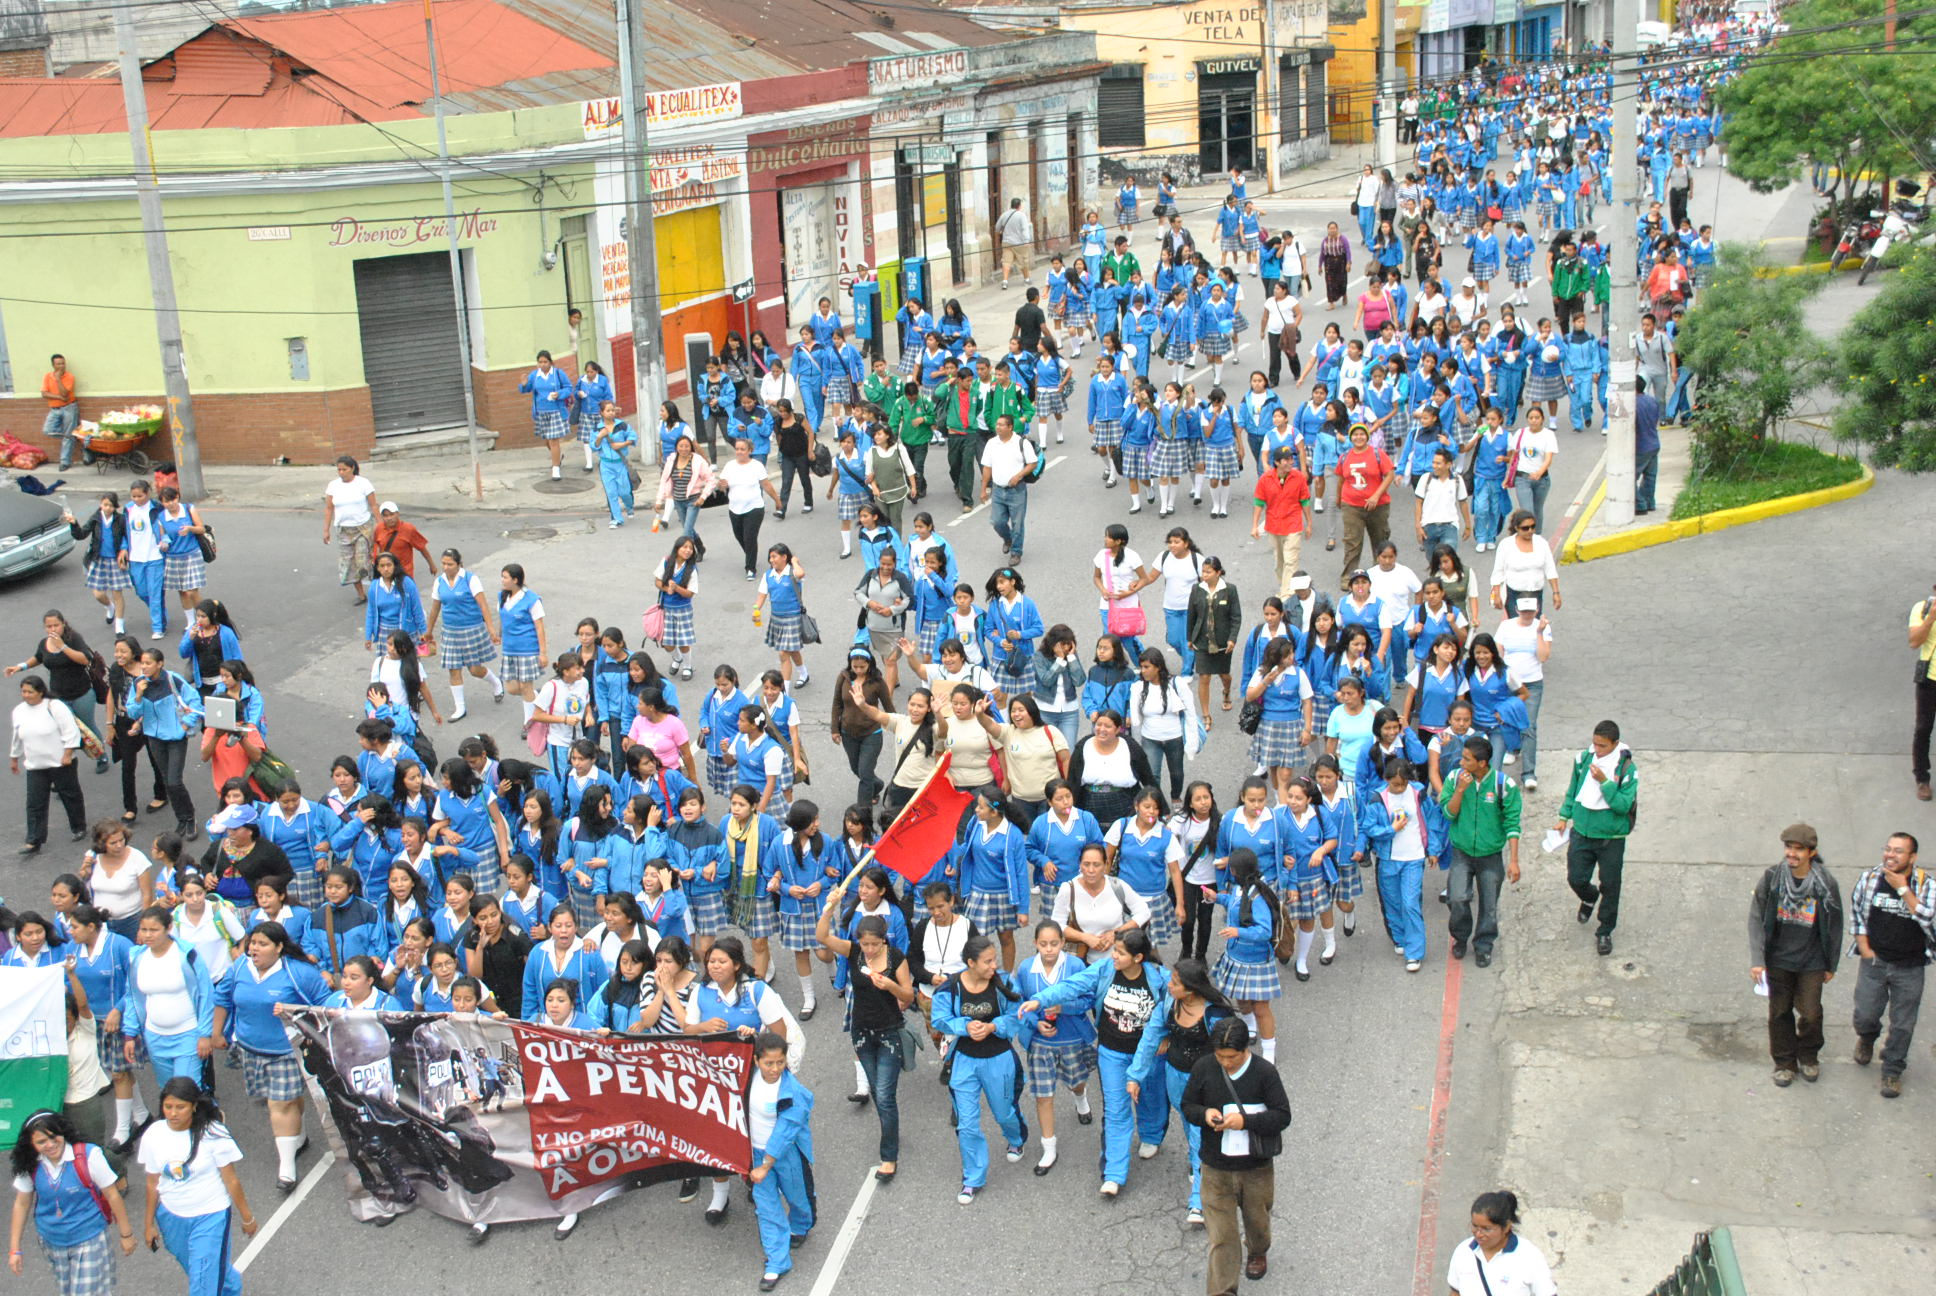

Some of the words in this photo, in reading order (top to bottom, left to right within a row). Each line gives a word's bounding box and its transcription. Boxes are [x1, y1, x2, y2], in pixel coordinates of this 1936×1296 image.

[1183, 10, 1233, 24] VENTA
[1240, 9, 1260, 21] DE
[1203, 26, 1244, 40] TELA
[874, 51, 965, 83] NATURISMO
[585, 99, 655, 126] ALMN
[660, 87, 732, 115] ECUALITEX
[456, 207, 498, 241] Mar
[602, 241, 627, 261] VENTA
[836, 197, 851, 291] NOVIAS
[167, 396, 186, 467] TAXI
[525, 1040, 586, 1066] QUE
[663, 1042, 746, 1076] EDUCACIÓ
[532, 1067, 571, 1103] A
[586, 1062, 748, 1138] PENSAR
[536, 1133, 548, 1148] Y
[554, 1131, 585, 1147] NO
[590, 1125, 627, 1141] POR
[633, 1123, 667, 1146] UNA
[551, 1166, 579, 1194] A
